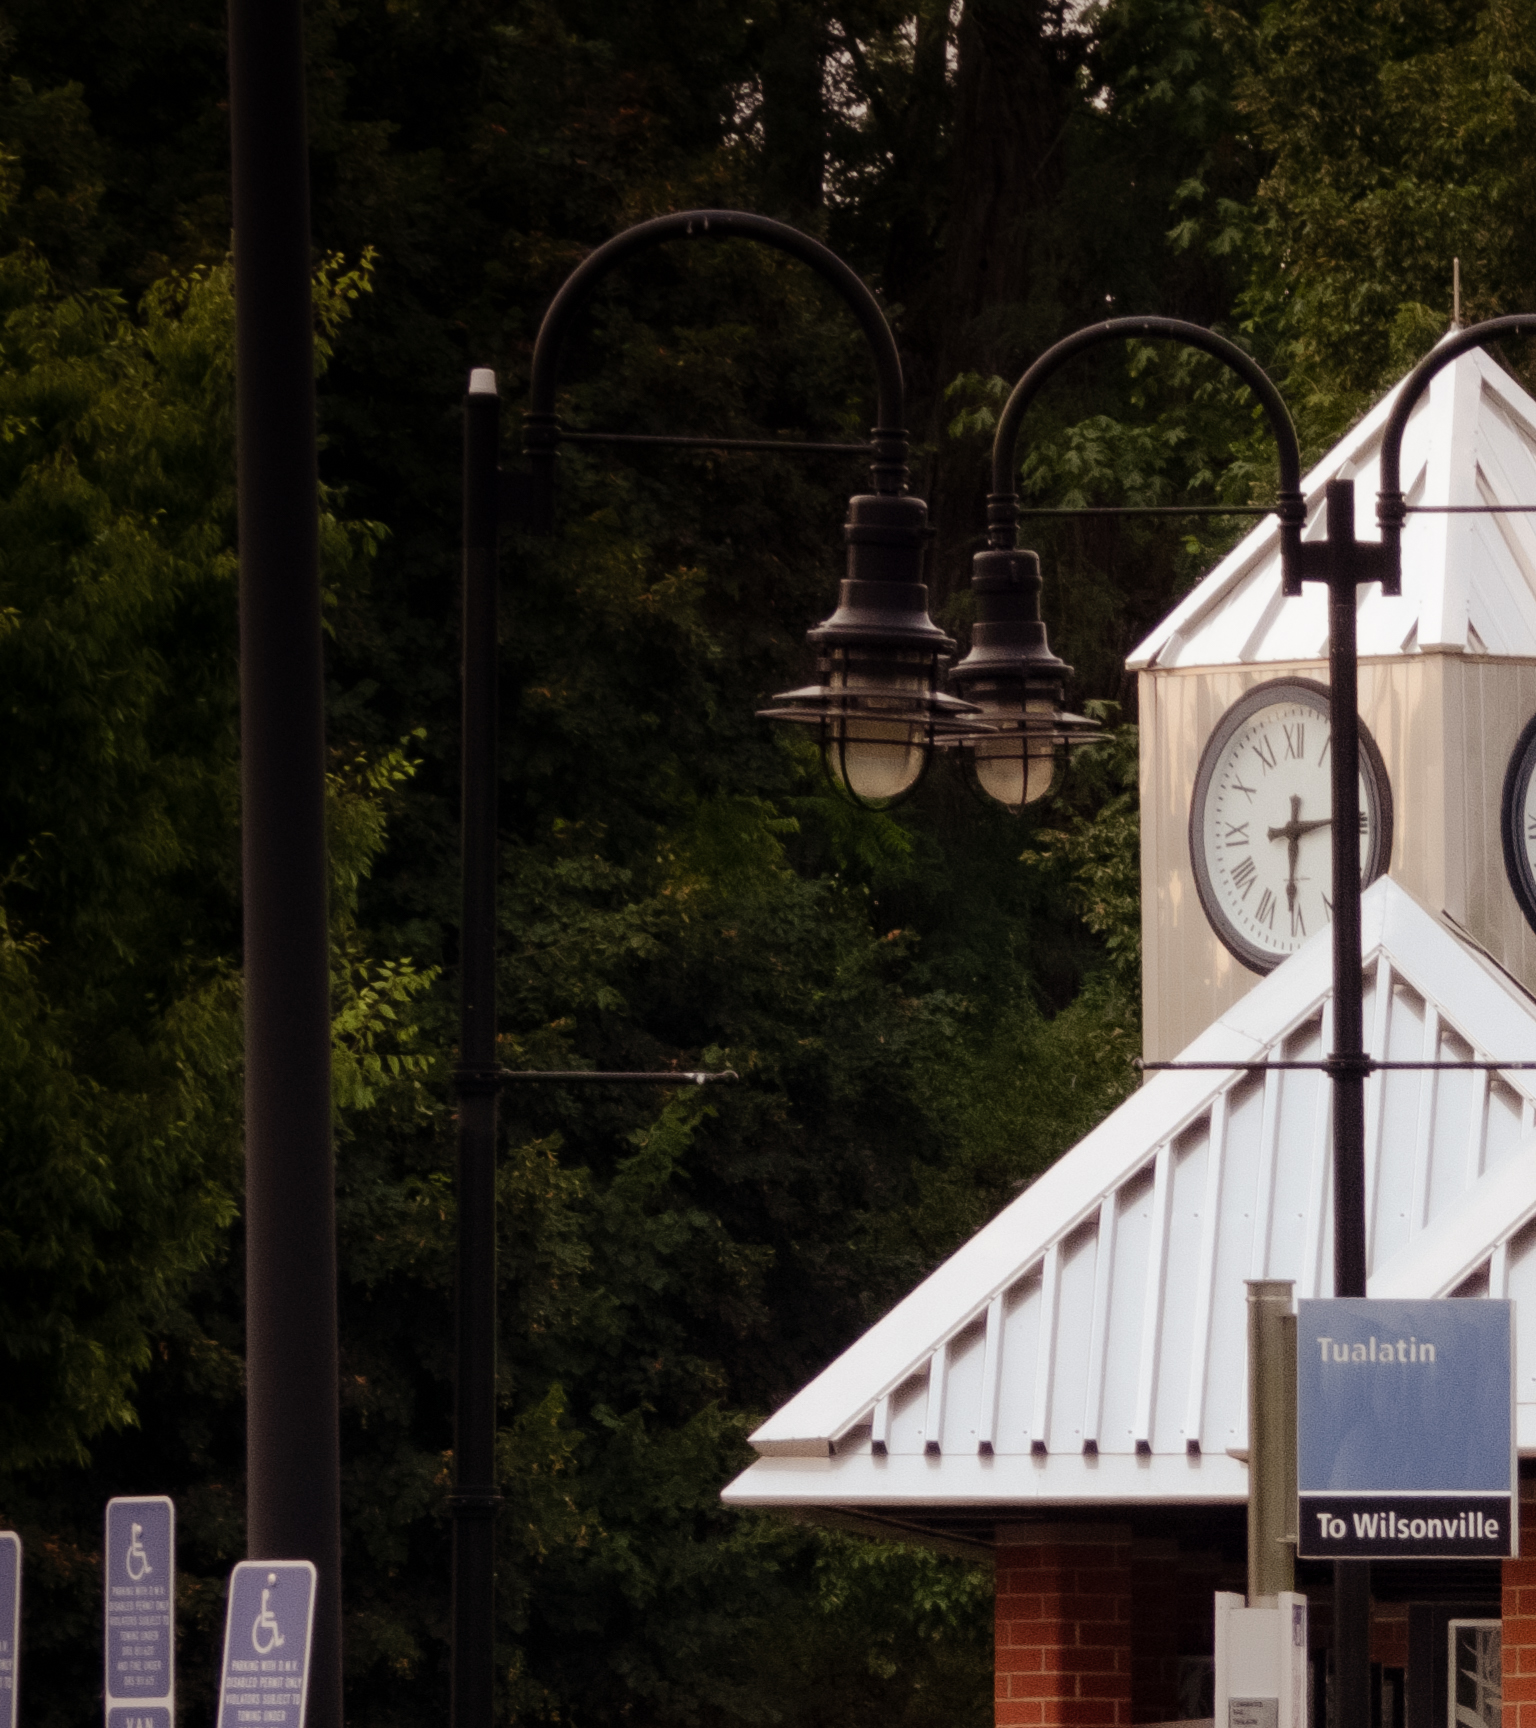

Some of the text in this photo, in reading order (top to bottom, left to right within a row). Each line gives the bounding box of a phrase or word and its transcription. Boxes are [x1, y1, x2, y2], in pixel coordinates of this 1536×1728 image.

[1316, 1336, 1436, 1364] Tualatin
[1316, 1511, 1500, 1540] To Wilsonville
